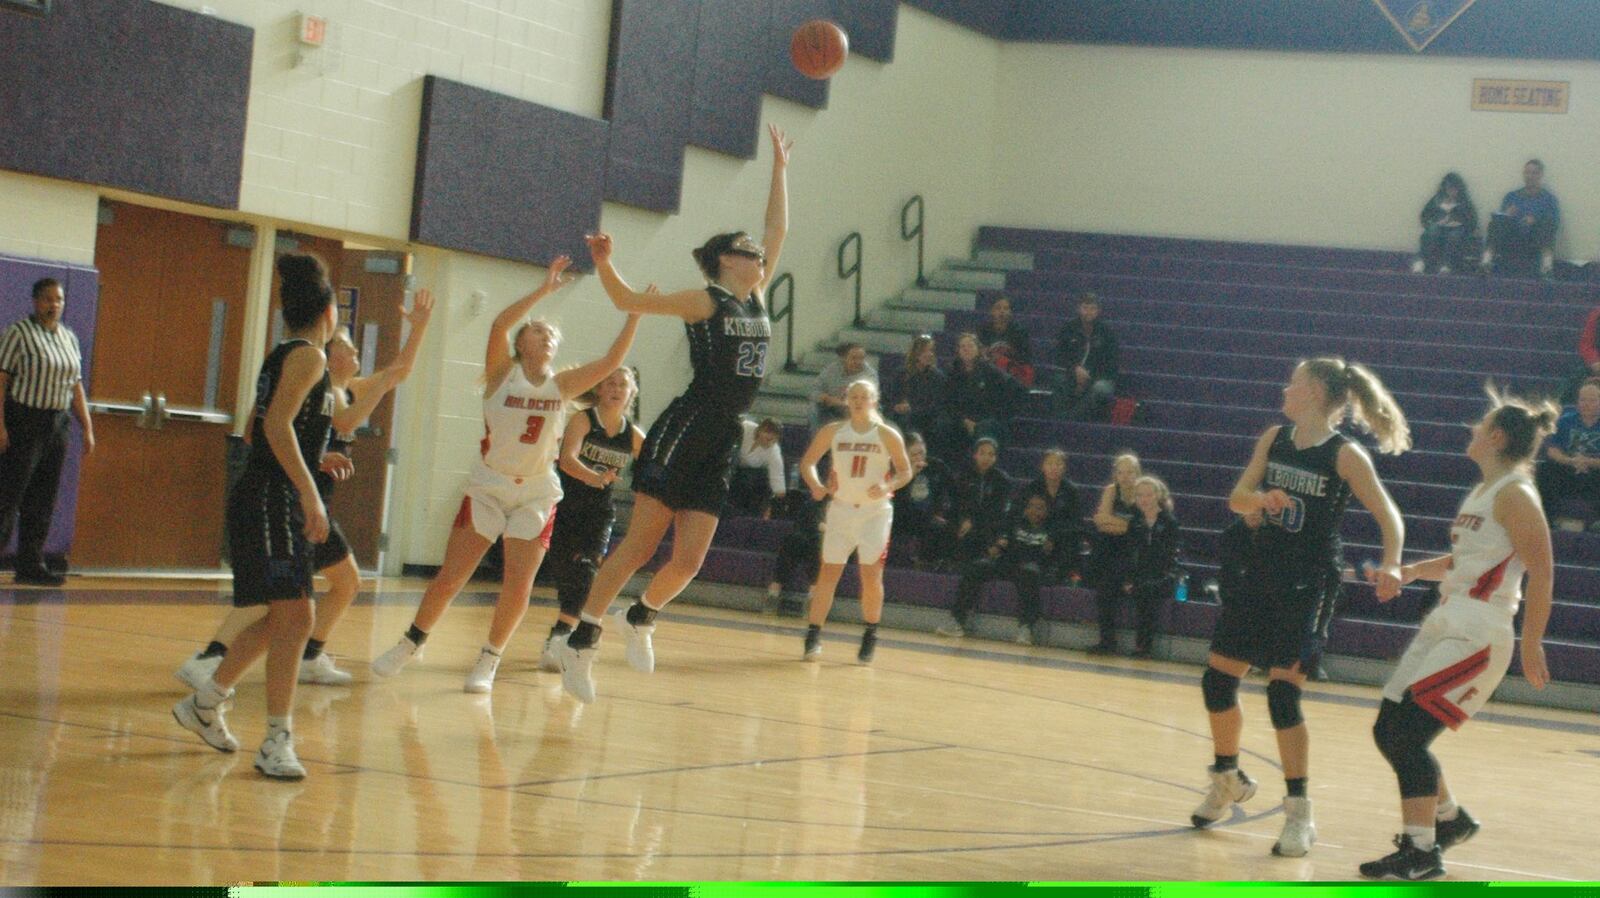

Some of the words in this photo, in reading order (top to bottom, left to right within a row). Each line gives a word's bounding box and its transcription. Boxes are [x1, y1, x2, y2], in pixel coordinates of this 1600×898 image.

[736, 341, 769, 378] 23
[519, 415, 546, 445] 3
[851, 455, 868, 478] 11
